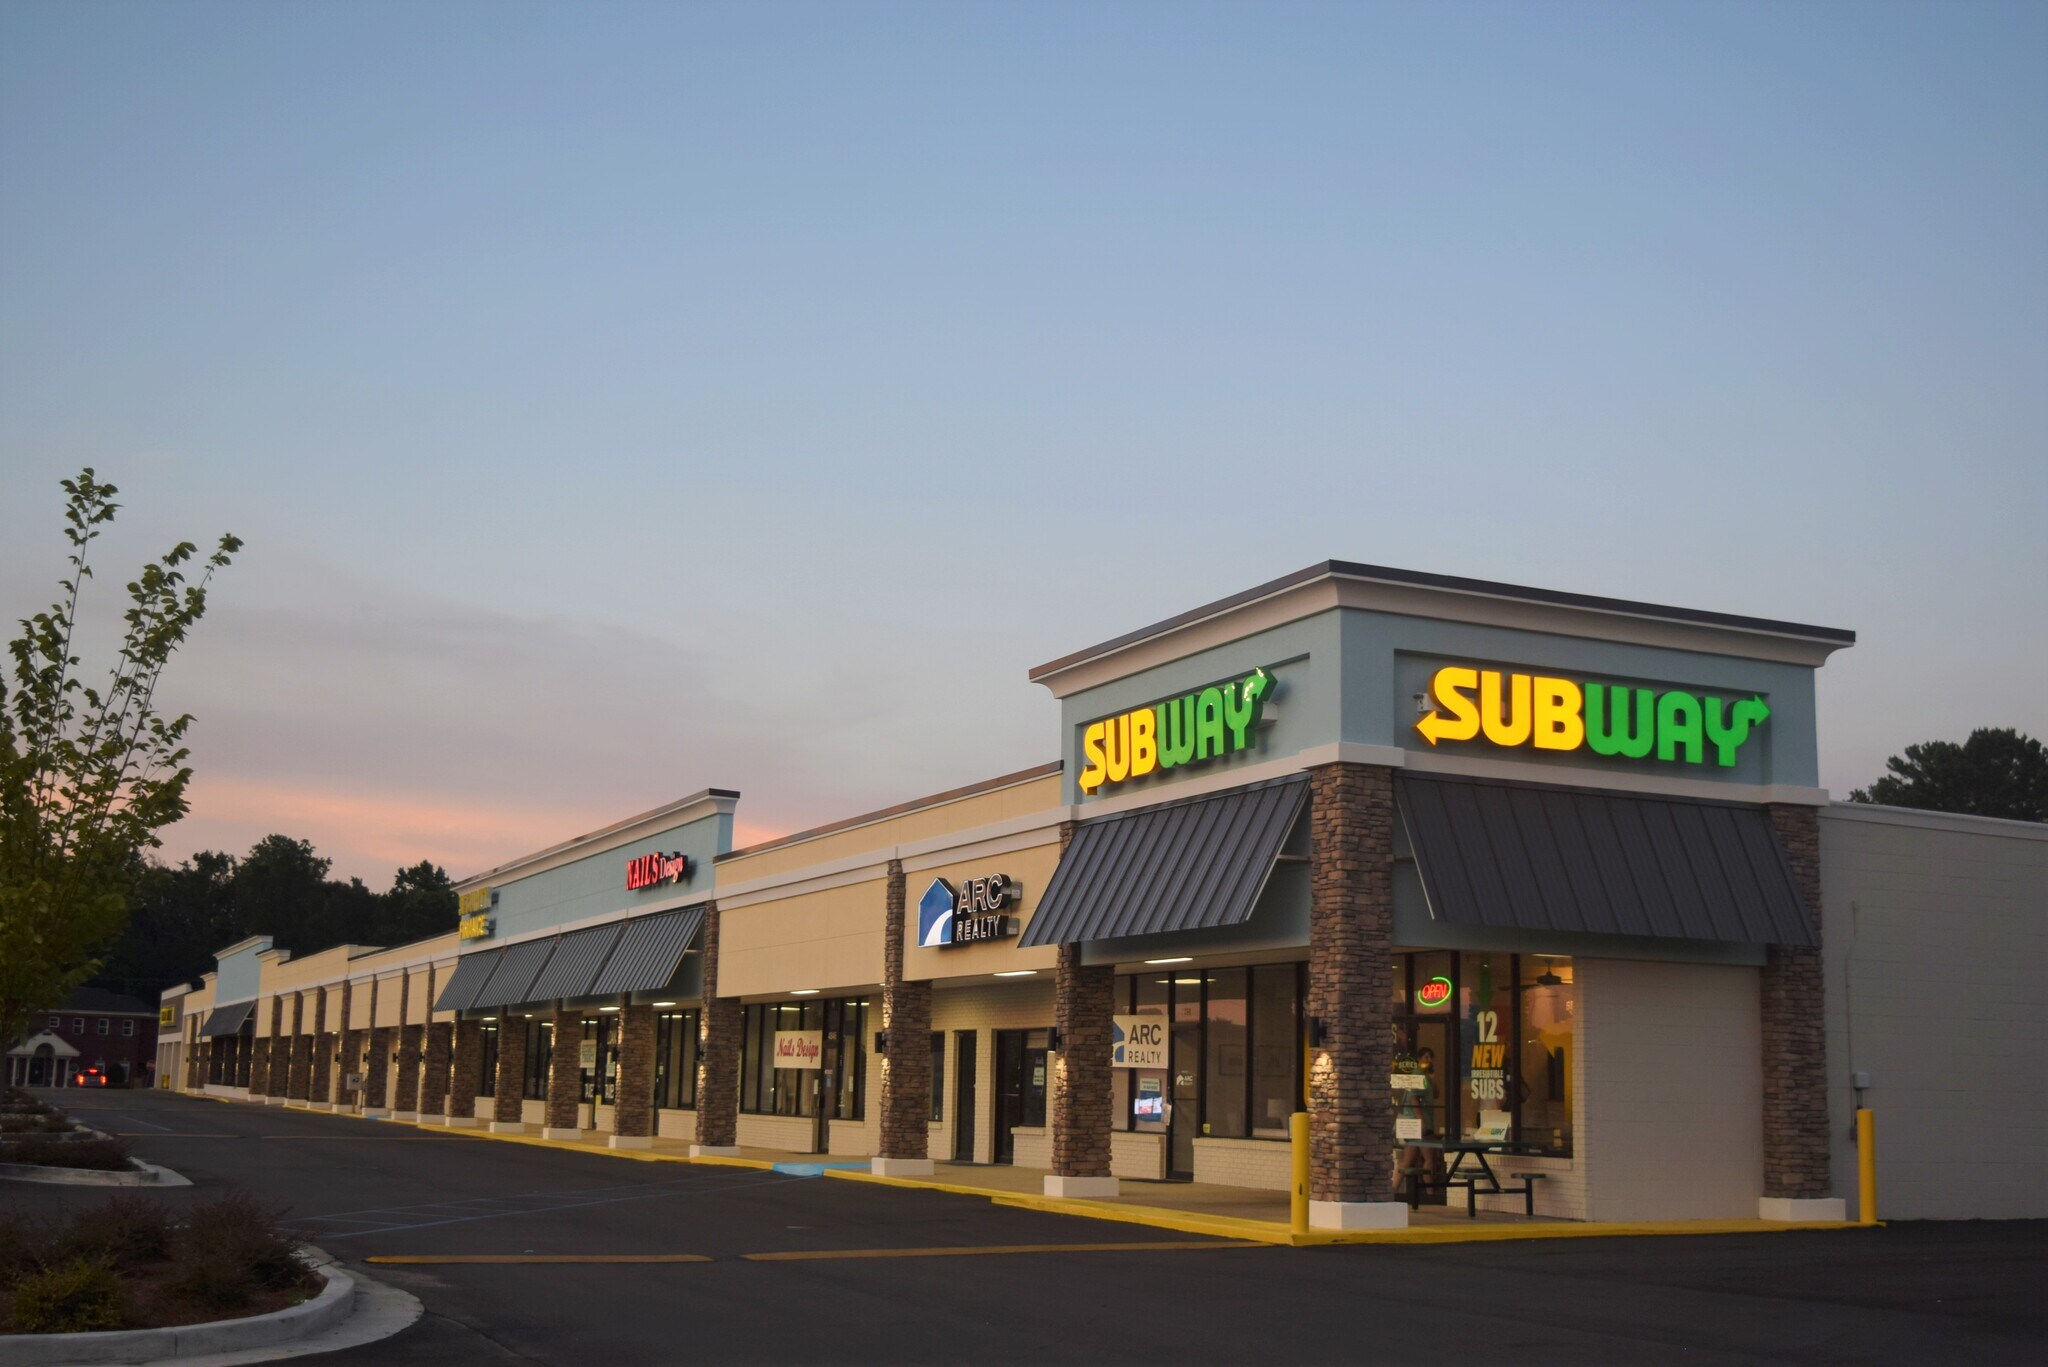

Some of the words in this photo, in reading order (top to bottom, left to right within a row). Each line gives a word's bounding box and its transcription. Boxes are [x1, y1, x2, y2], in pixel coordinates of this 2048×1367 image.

[1411, 666, 1771, 767] SUBWAY
[1078, 666, 1272, 796] SUBWAY
[626, 852, 660, 891] NAILS
[660, 851, 684, 883] Design
[956, 873, 1003, 915] ARC
[956, 914, 1001, 942] REALTY
[1421, 983, 1448, 999] OPEN
[1128, 1024, 1162, 1046] ARC
[1476, 1010, 1499, 1043] 12
[776, 1037, 795, 1057] Nails
[796, 1037, 819, 1063] Design
[1128, 1050, 1162, 1064] REALTY
[1471, 1044, 1506, 1069] NEW
[1471, 1078, 1505, 1100] SUBS
